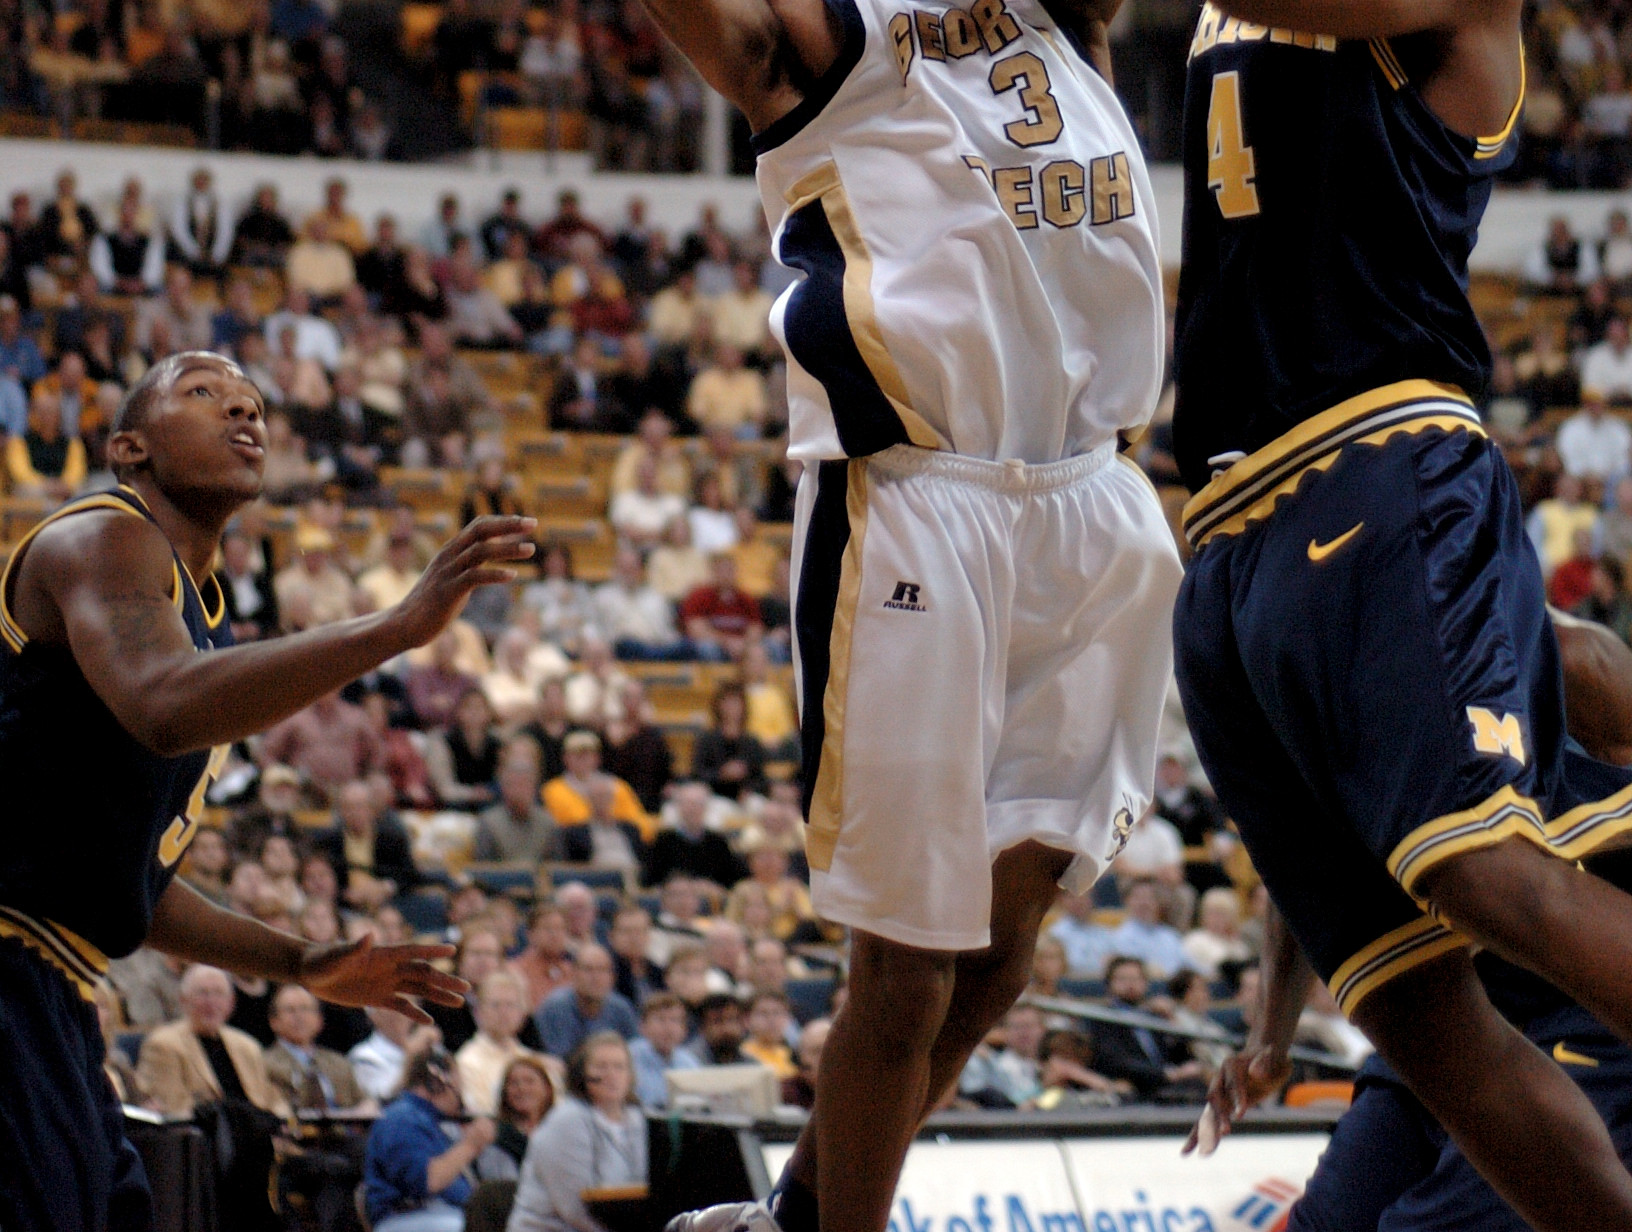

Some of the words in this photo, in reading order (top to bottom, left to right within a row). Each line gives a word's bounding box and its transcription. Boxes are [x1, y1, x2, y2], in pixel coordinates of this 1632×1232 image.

[988, 51, 1064, 148] 3
[1207, 71, 1260, 218] 4
[883, 601, 926, 612] RUSSELL
[1466, 706, 1525, 766] M
